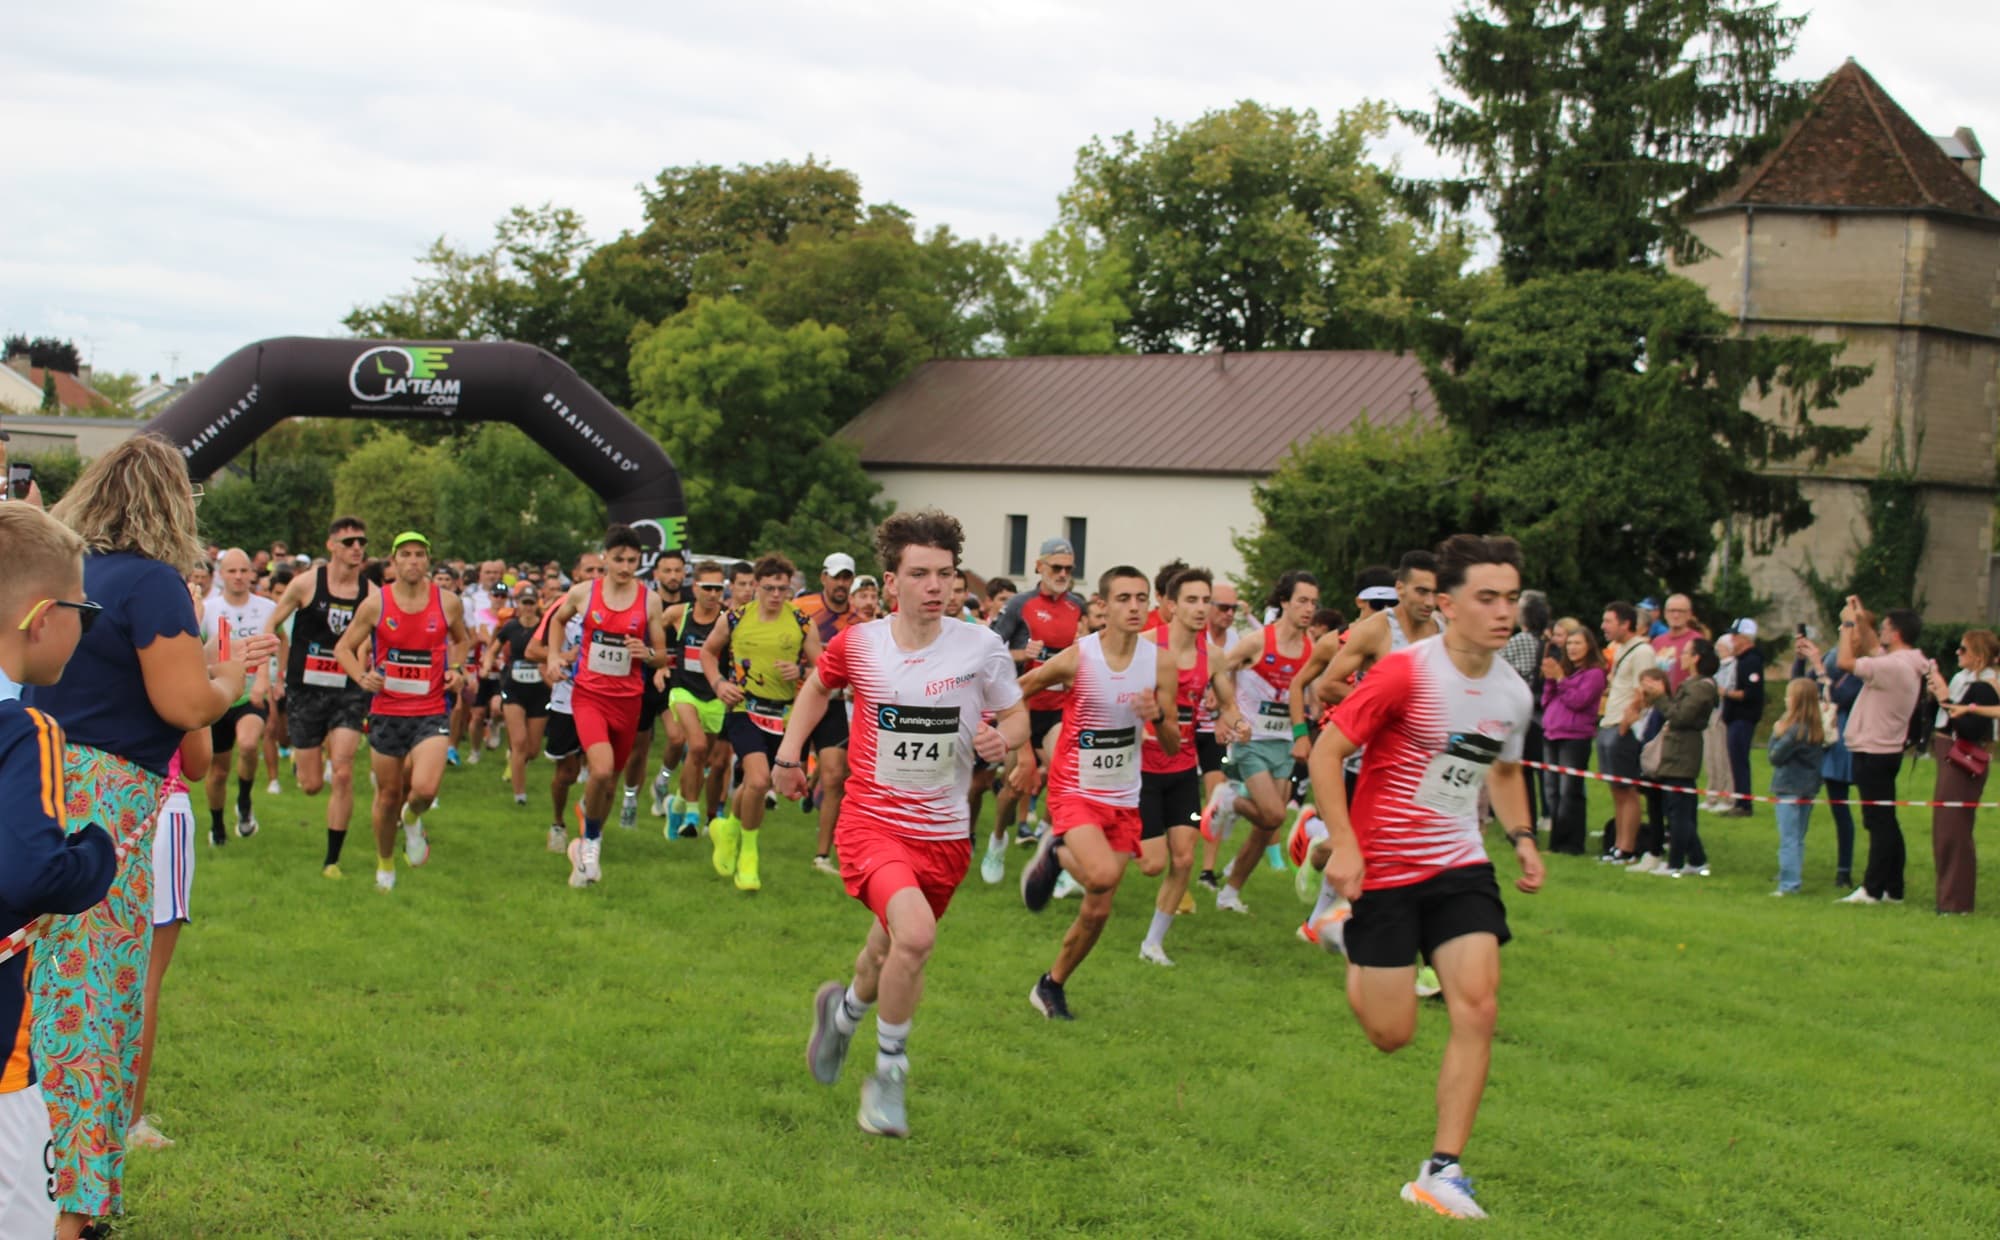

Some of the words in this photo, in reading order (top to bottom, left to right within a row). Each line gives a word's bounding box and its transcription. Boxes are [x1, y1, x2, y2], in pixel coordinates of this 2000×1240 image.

[598, 649, 623, 662] 413
[317, 659, 339, 671] 224
[398, 666, 420, 679] 123
[893, 741, 940, 761] 474
[1092, 753, 1124, 769] 402
